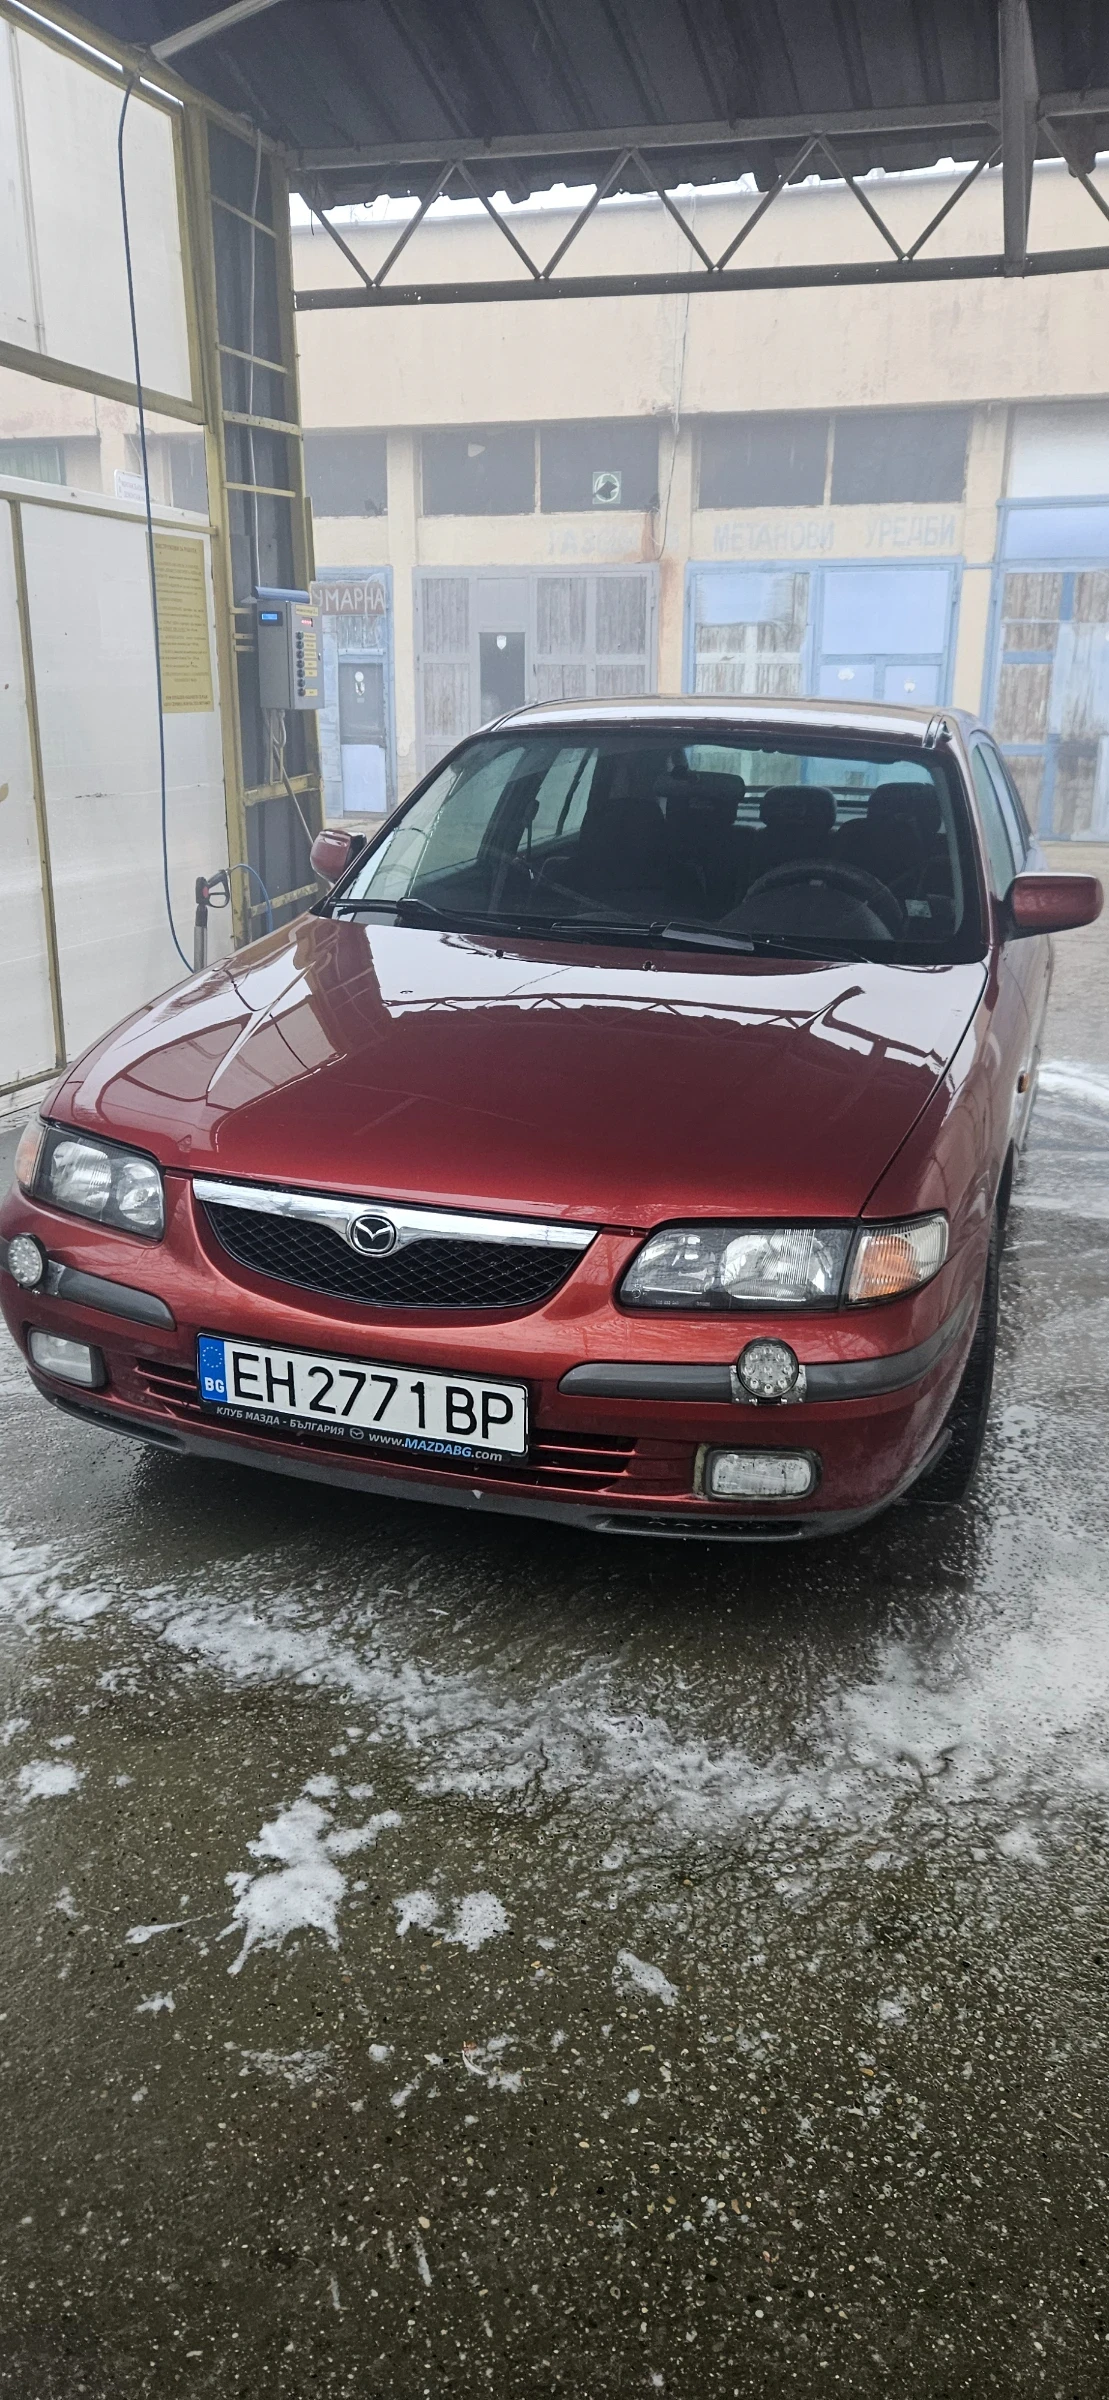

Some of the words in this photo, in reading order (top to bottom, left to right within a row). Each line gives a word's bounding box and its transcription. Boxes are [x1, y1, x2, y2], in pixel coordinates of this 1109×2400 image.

[713, 519, 835, 552] МЕТАНОВИ
[864, 514, 956, 549] УРЕДБИ
[204, 1376, 226, 1394] BG
[216, 1406, 244, 1420] КЛУБ
[245, 1410, 281, 1426] МАЗДА
[289, 1418, 345, 1437] БЪЛГАРИЯ
[368, 1432, 503, 1463] www.MAZDABG.com
